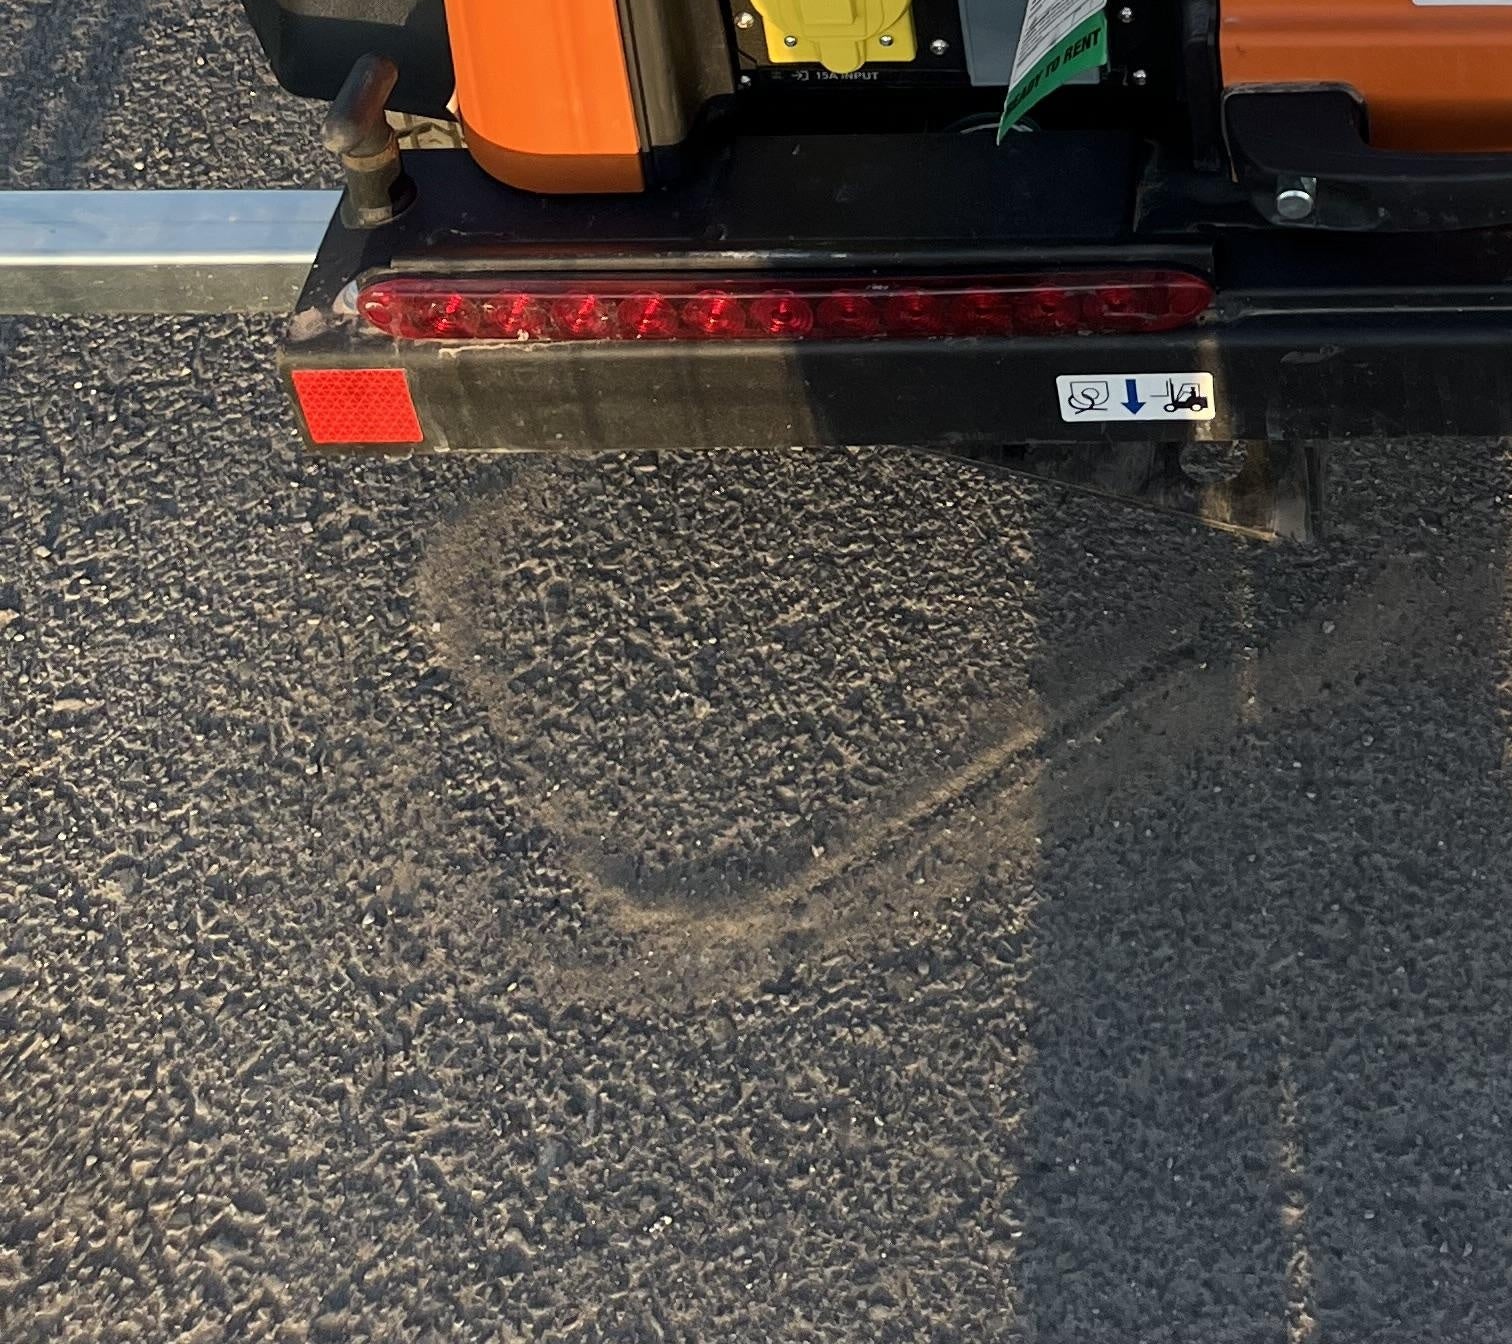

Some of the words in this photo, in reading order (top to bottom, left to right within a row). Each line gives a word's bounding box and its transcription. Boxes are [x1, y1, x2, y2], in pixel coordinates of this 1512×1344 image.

[1045, 51, 1062, 75] TO
[1063, 27, 1102, 64] RENT
[815, 71, 838, 81] 15A
[841, 71, 879, 80] INPUT
